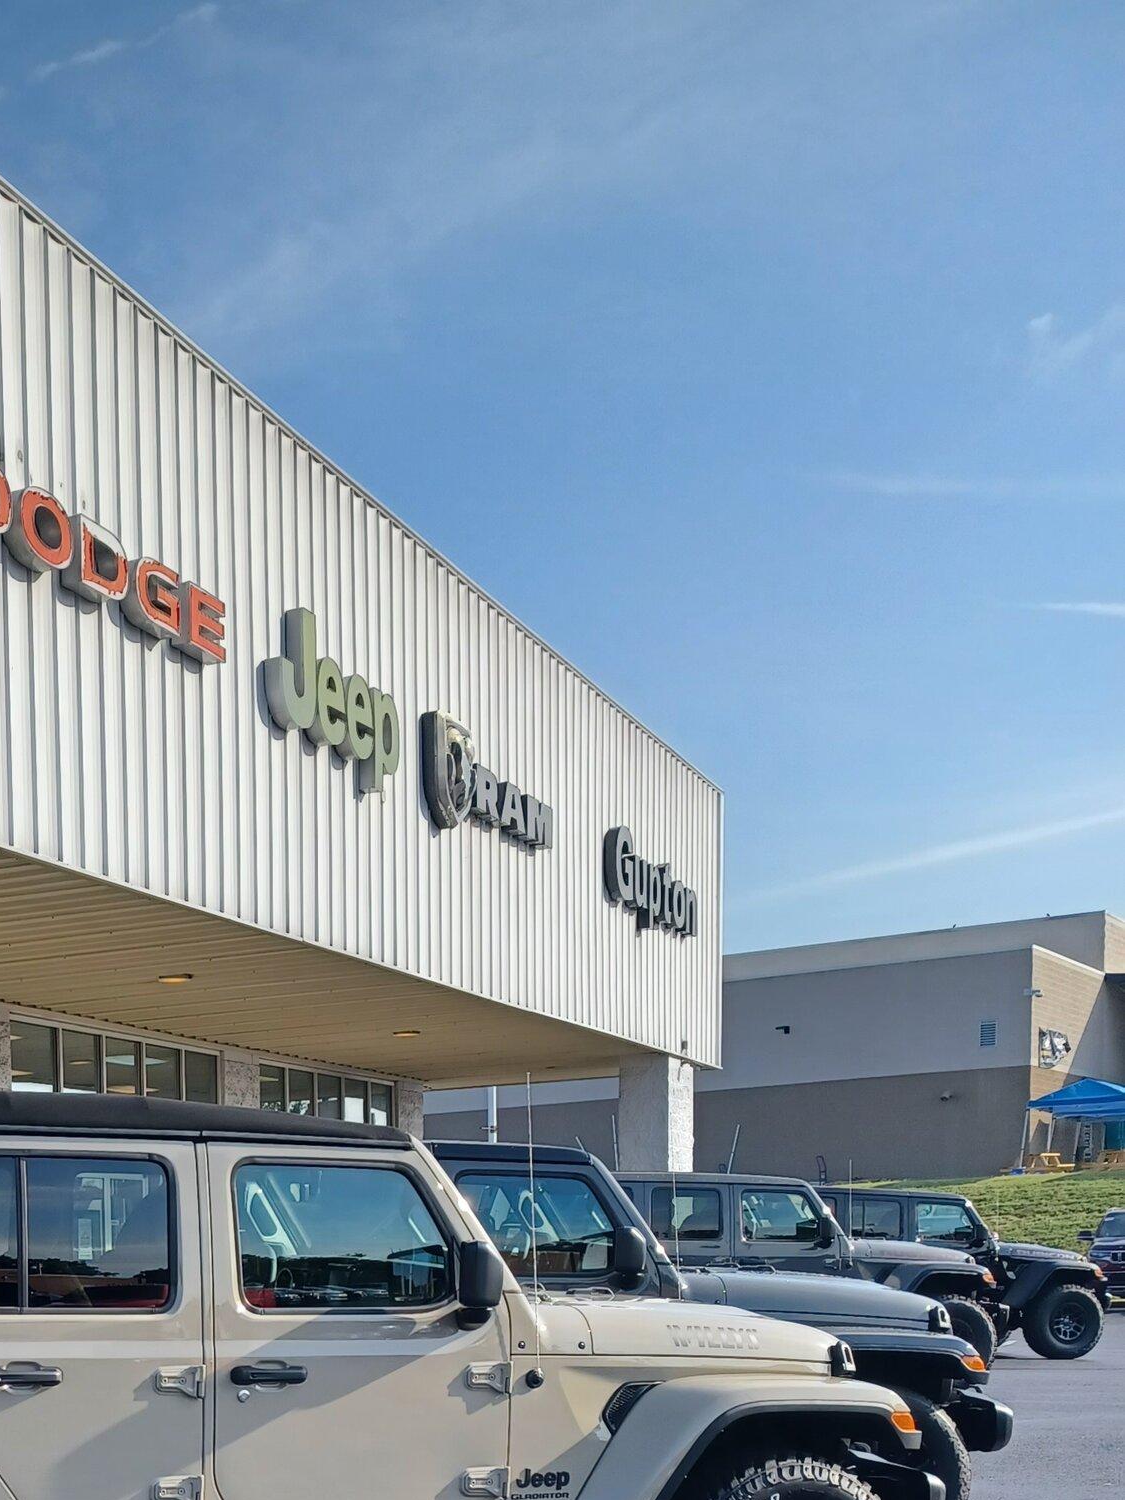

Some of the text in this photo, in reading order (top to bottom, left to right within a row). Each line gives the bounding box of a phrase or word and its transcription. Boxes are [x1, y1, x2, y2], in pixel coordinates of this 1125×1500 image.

[264, 607, 401, 794] Jeep
[472, 762, 554, 850] RAM
[603, 825, 697, 938] Gupton
[510, 1492, 570, 1500] GLADIATOR
[516, 1468, 570, 1491] Jeep
